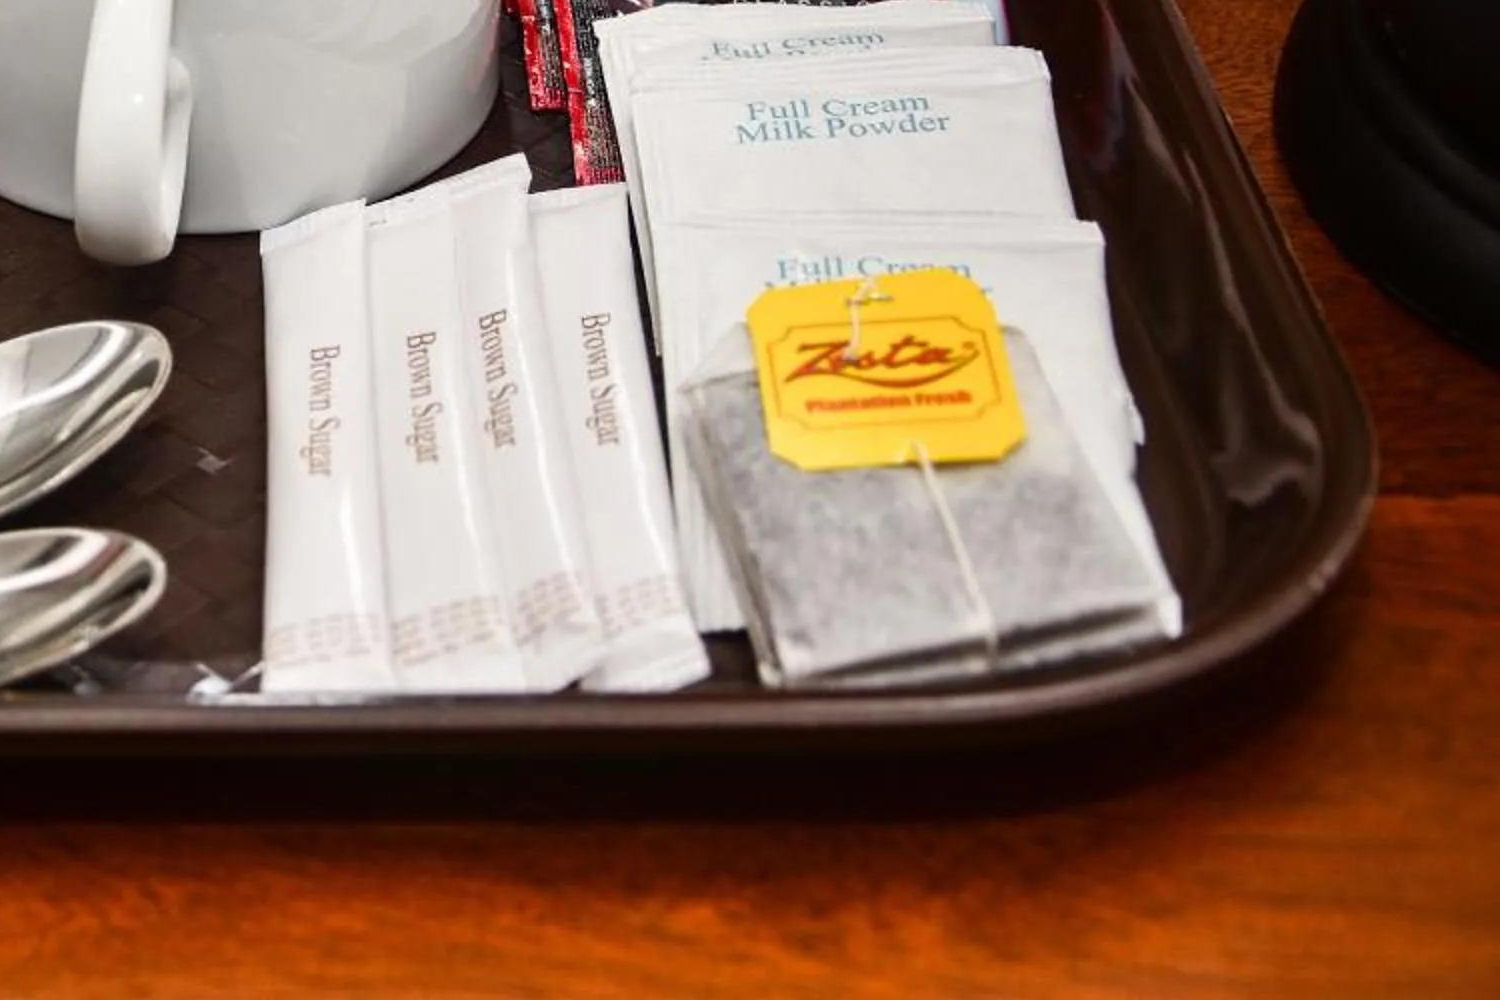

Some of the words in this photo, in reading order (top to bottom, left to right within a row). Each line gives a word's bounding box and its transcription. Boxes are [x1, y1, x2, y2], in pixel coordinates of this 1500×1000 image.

[781, 31, 885, 51] Cream
[734, 117, 817, 144] Milk
[825, 113, 951, 139] Powder
[747, 99, 811, 121] Full
[821, 94, 931, 118] Cream
[776, 255, 843, 280] Full
[309, 344, 342, 412] Brown
[406, 330, 438, 399] Brown
[478, 308, 508, 383] Brown
[581, 311, 612, 381] Brown
[298, 415, 342, 479] Sugar
[404, 401, 444, 466] Sugar
[483, 381, 519, 450] Sugar
[585, 382, 620, 448] Sugar
